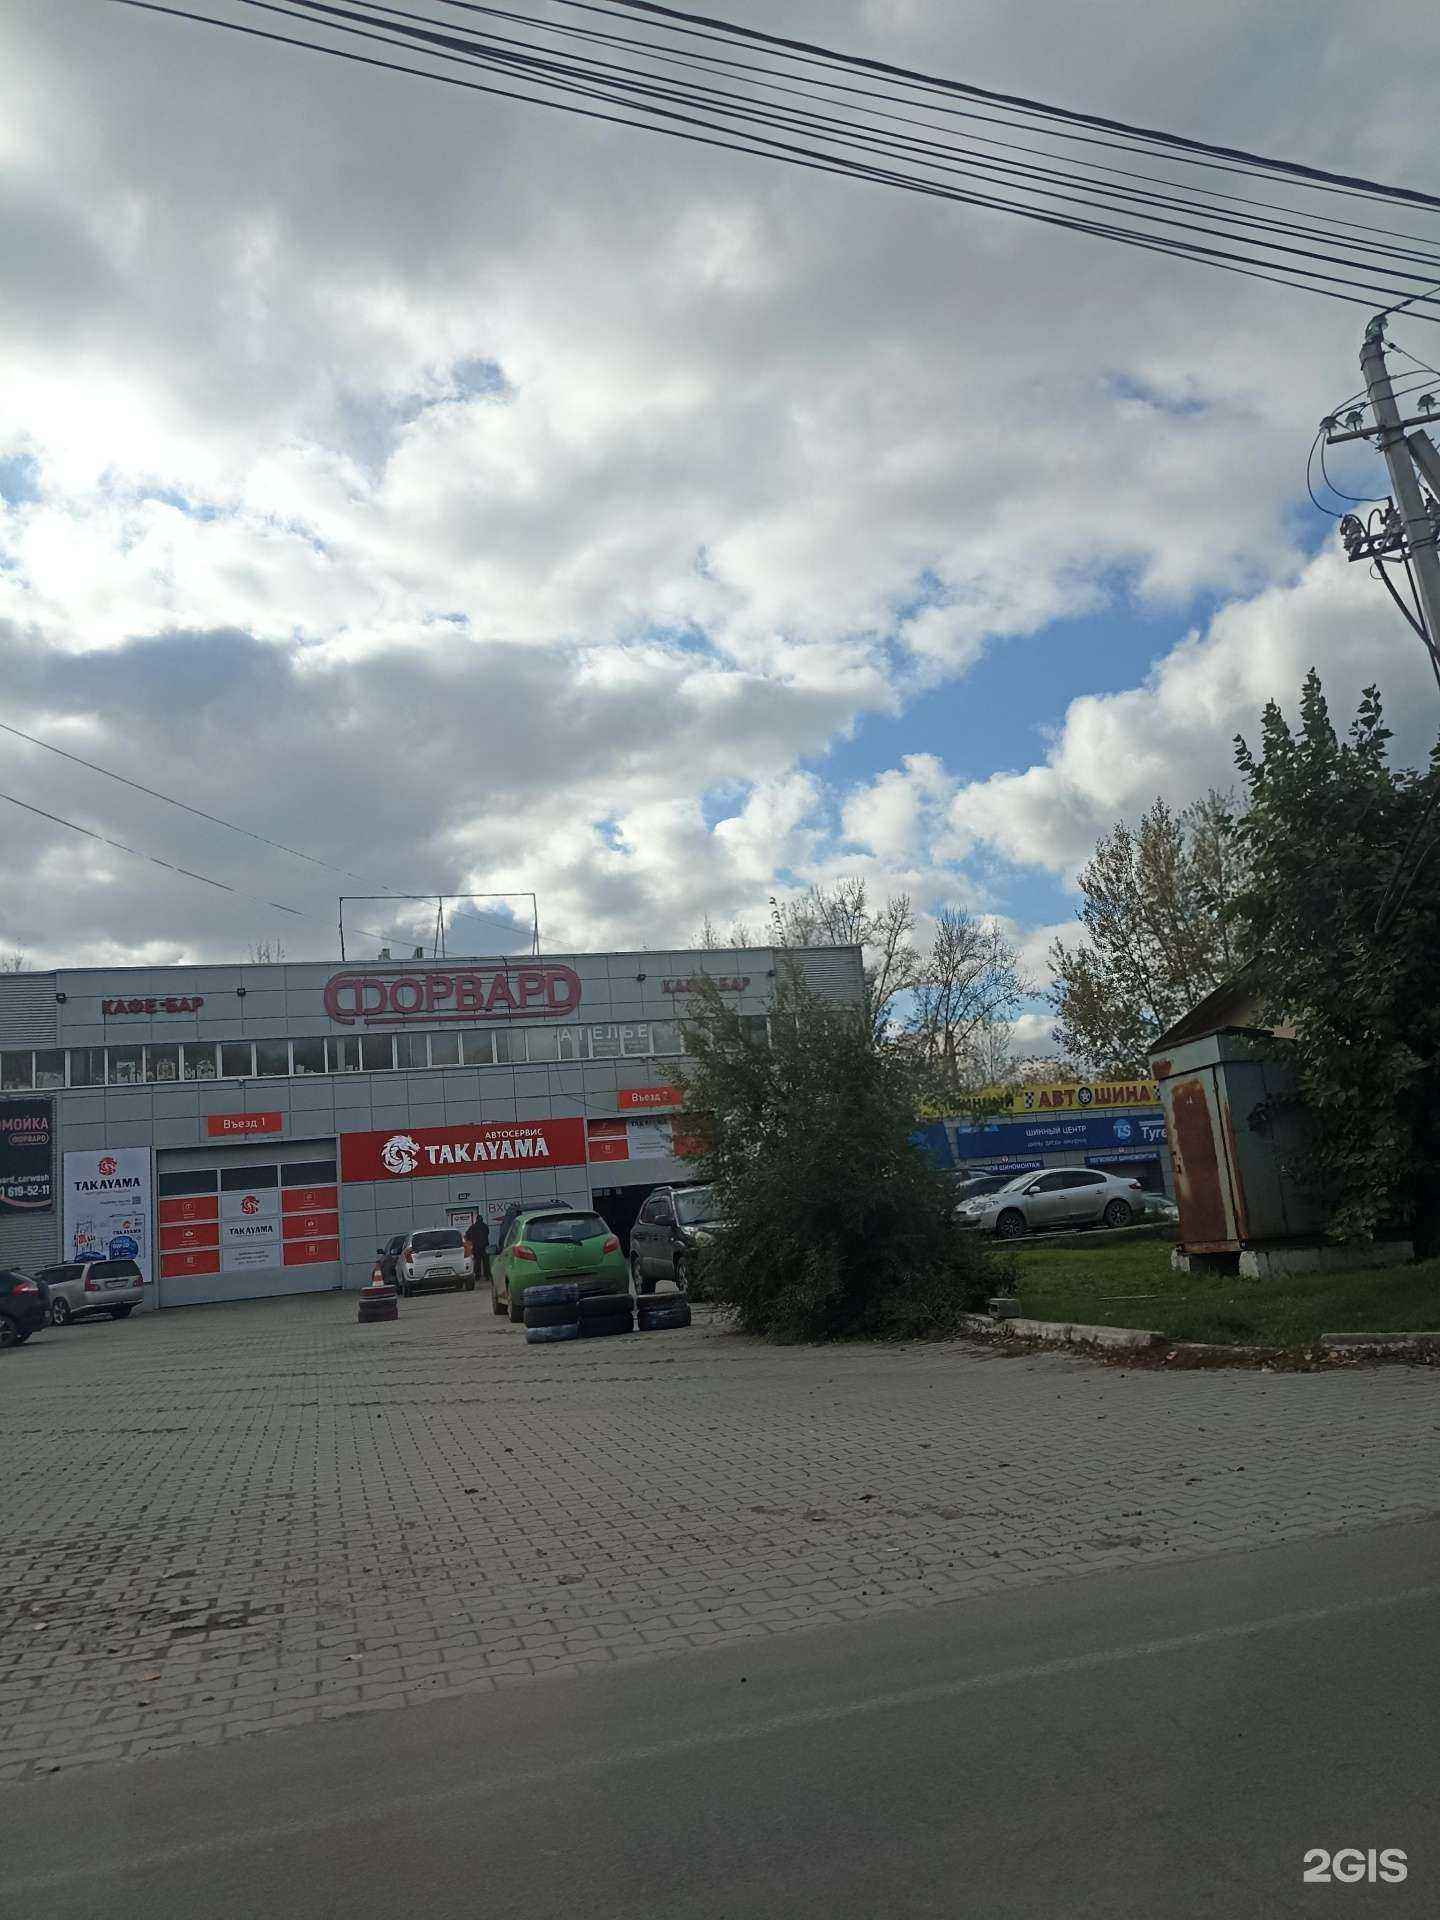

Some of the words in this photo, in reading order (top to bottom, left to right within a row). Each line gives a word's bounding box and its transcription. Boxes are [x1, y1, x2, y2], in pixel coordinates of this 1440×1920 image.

[102, 997, 204, 1015] КАФЕ-БАР
[560, 1023, 649, 1041] АТЕЛЬЕ
[0, 1114, 49, 1131] МОЙКА
[223, 1119, 258, 1130] Въезд
[261, 1117, 266, 1127] 1
[484, 1127, 544, 1140] АВТОСЕРВИС
[1025, 1126, 1061, 1137] ШИННЫЙ
[1062, 1124, 1087, 1135] ЦЕНТР
[1141, 1126, 1168, 1141] Tyre
[424, 1137, 550, 1165] TAKAYAMA
[999, 1162, 1041, 1171] ШИНОМОНТАЖ
[8, 1184, 50, 1198] 619-52-11
[74, 1178, 141, 1191] TAKAYAMA
[229, 1225, 273, 1235] TAKAYAMA
